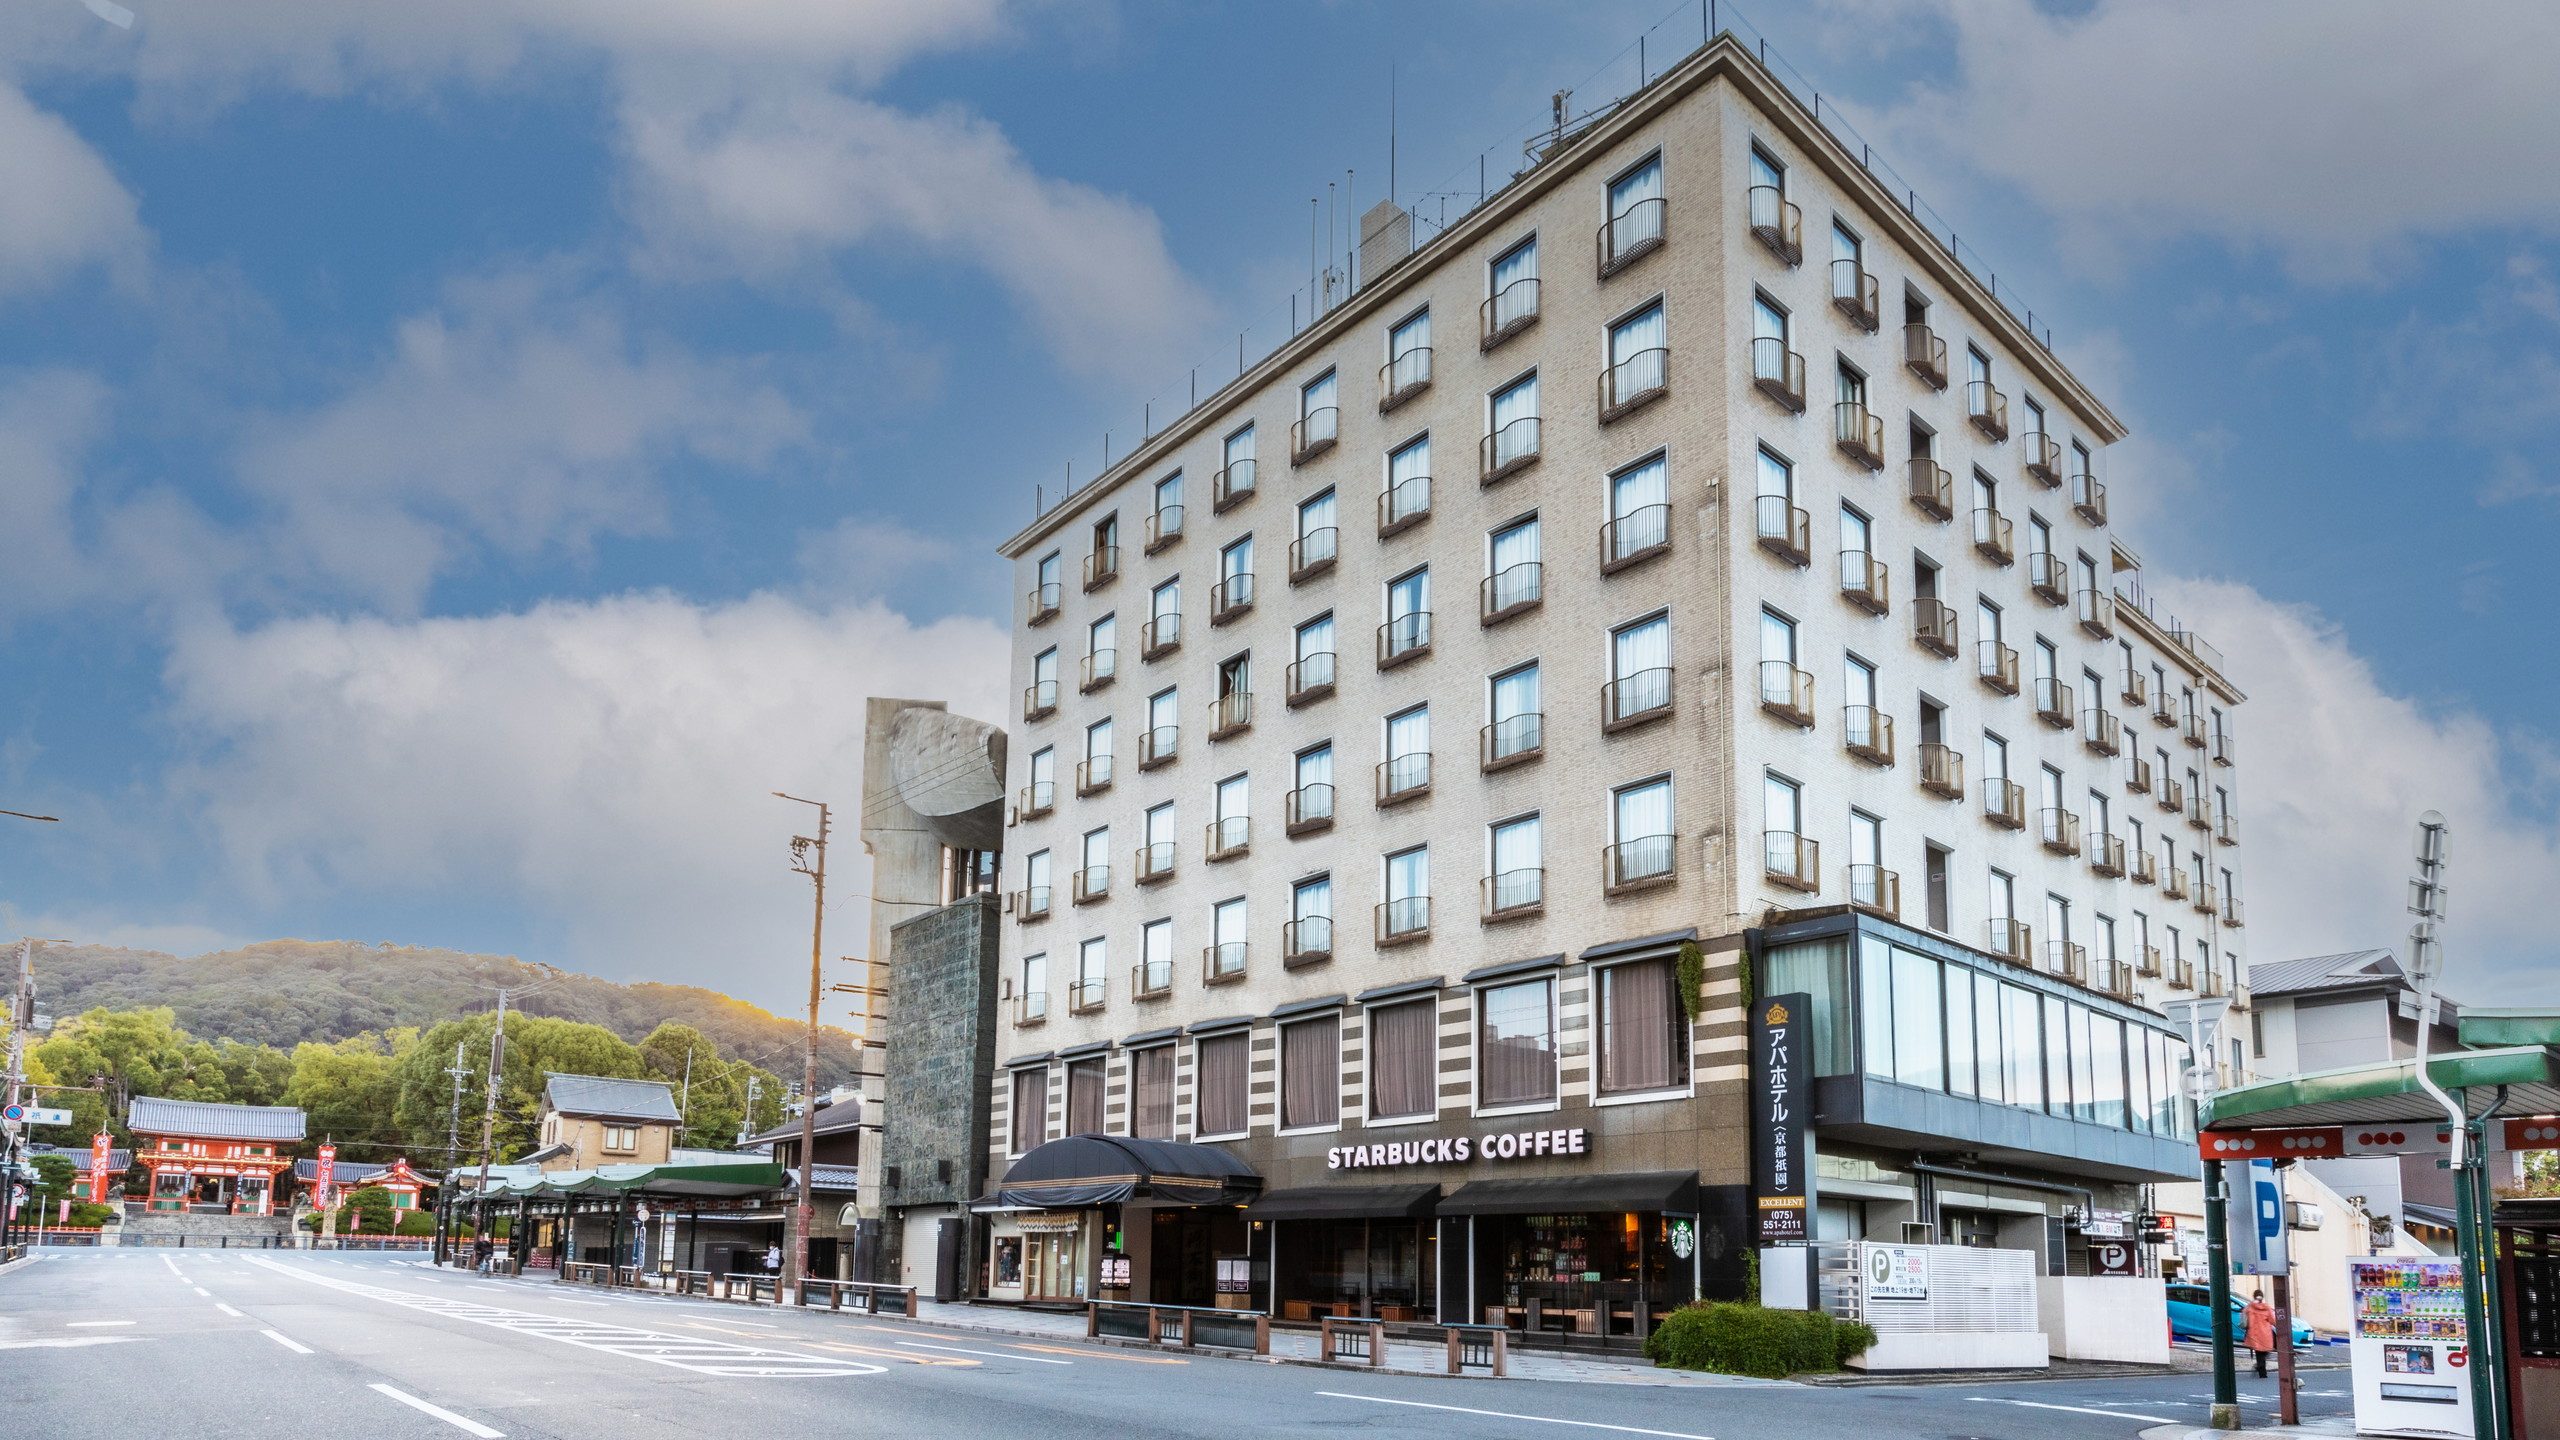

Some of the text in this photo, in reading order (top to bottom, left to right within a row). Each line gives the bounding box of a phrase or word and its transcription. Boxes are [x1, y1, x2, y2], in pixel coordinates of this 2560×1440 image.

[1769, 1028, 1788, 1122] アパホテル
[1328, 1128, 1585, 1169] STARBUCKS COFFEE
[1760, 1198, 1804, 1207] EXCELLENT
[1771, 1210, 1793, 1220] (075)
[2160, 1216, 2173, 1229] 満
[2255, 1181, 2281, 1261] P
[1763, 1220, 1801, 1229] 551-2111
[2106, 1247, 2122, 1264] P
[1875, 1253, 1887, 1280] P
